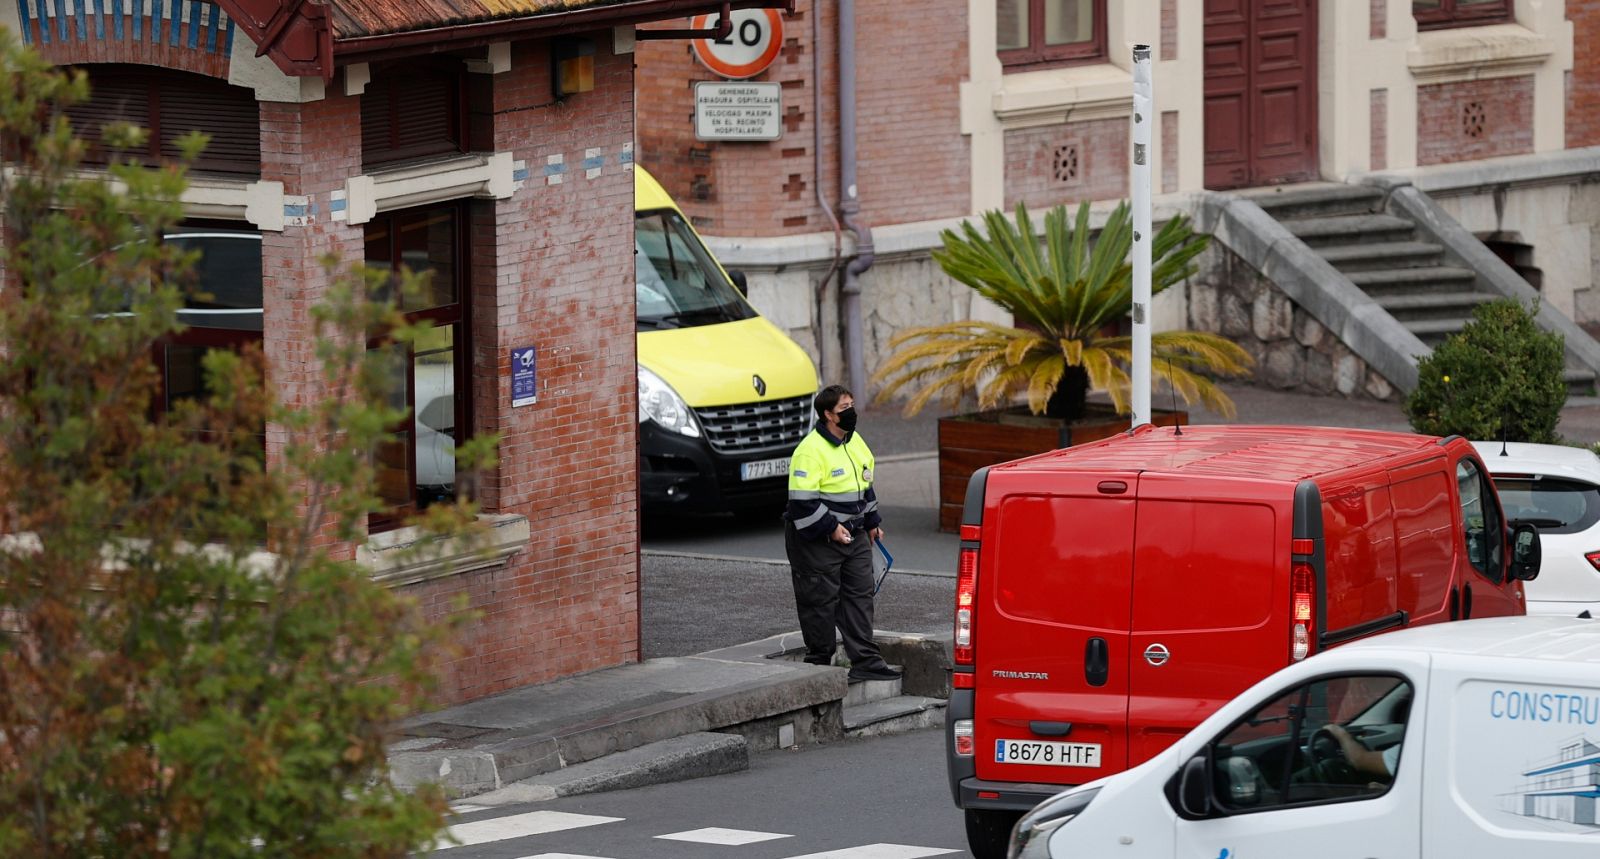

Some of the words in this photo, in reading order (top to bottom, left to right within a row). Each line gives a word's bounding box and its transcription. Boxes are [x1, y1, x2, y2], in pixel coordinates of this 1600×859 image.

[748, 462, 772, 477] 7773
[992, 670, 1049, 680] PRIMASTAR
[1490, 690, 1599, 725] CONSTRU
[1009, 743, 1054, 762] 8678
[1060, 745, 1096, 764] HTF
